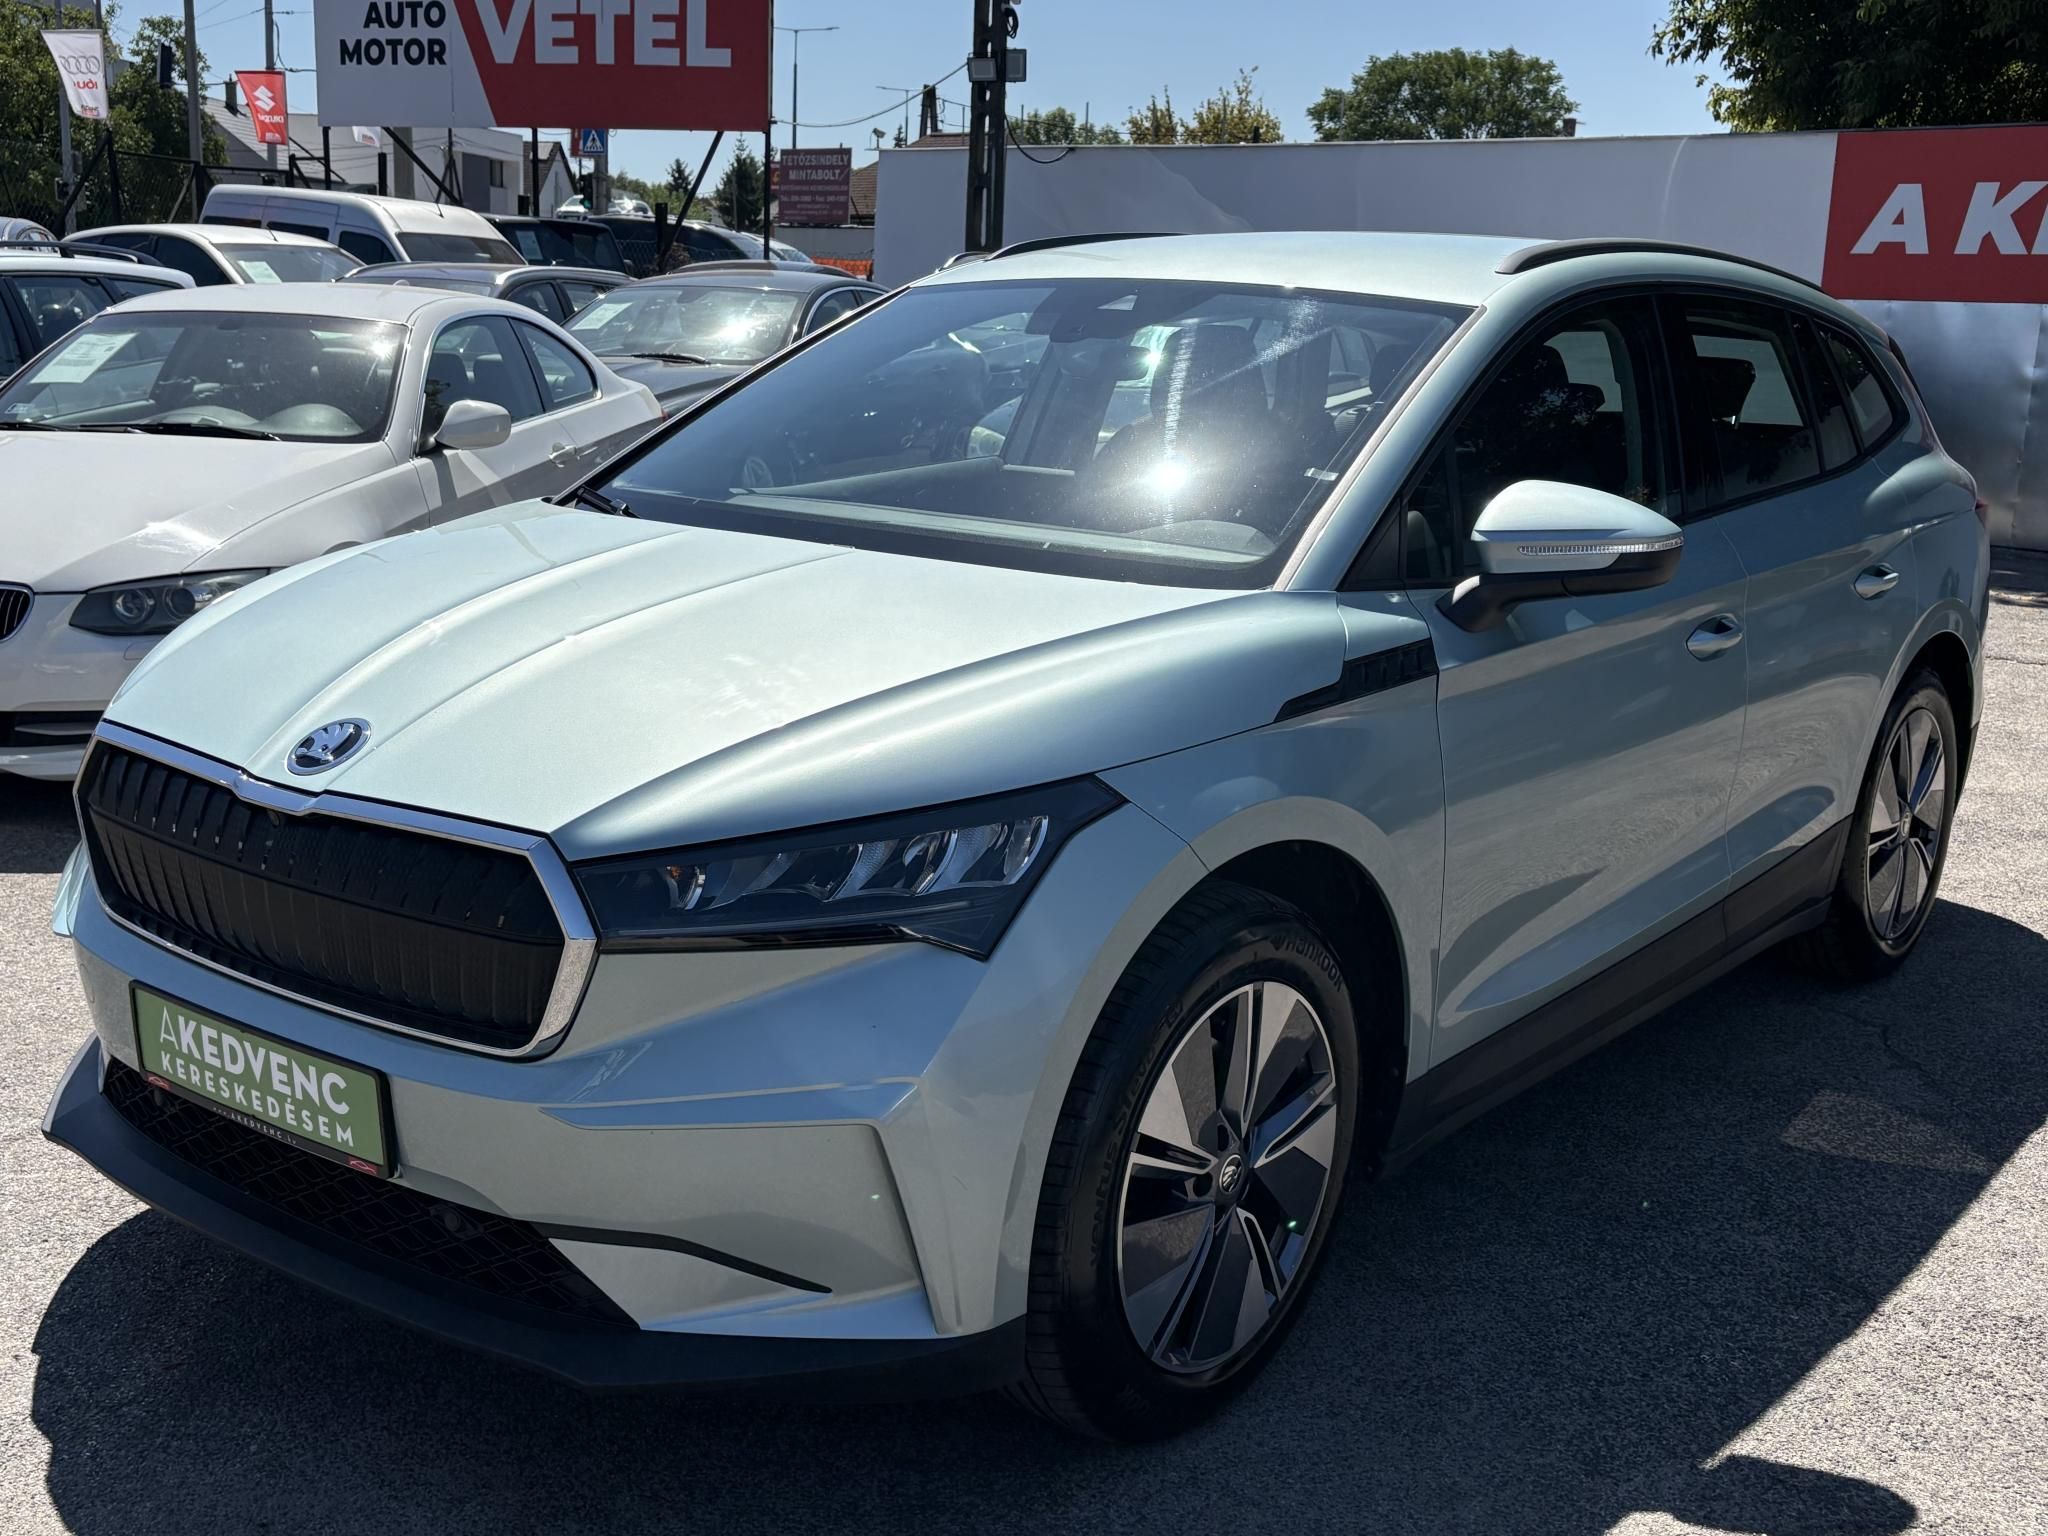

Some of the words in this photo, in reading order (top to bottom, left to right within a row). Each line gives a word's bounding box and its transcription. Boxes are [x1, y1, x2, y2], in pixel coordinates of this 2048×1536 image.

[363, 0, 446, 29] AUTO
[339, 38, 447, 66] MOTOR
[788, 169, 840, 181] MINTABOLT
[1849, 183, 1929, 255] A
[159, 1005, 351, 1116] AKEDVENC
[160, 1050, 355, 1147] KERESKEDÉSEM
